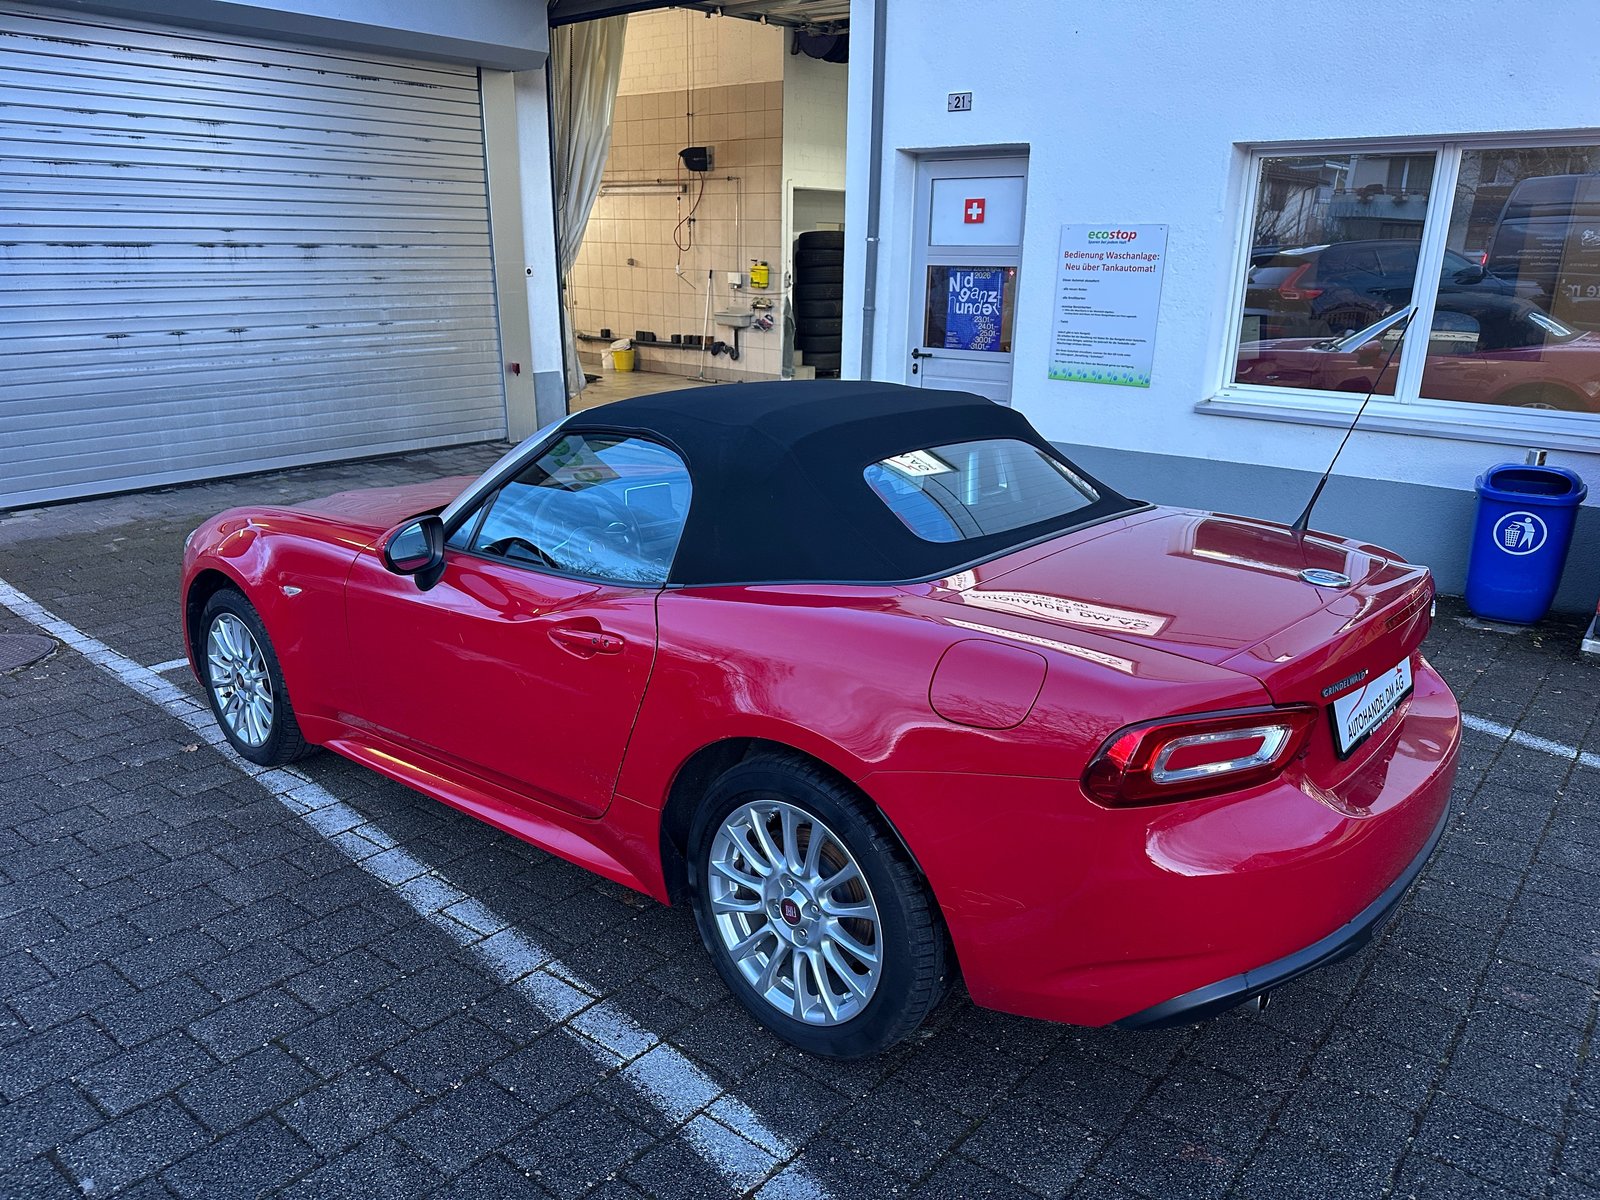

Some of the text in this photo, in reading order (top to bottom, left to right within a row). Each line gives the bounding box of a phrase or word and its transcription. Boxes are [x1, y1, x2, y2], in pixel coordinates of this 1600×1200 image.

[954, 95, 965, 109] 21
[1088, 229, 1138, 242] ecostop
[1064, 250, 1160, 262] Bedienung Waschanlage:
[1065, 263, 1156, 273] Neu über Tankautomat!
[974, 271, 991, 280] 2026
[958, 287, 998, 303] ganz
[1322, 671, 1366, 698] GRINDELWALD
[1346, 693, 1387, 742] AUTOHANDEL
[1385, 683, 1396, 703] DM
[1395, 674, 1404, 695] AG
